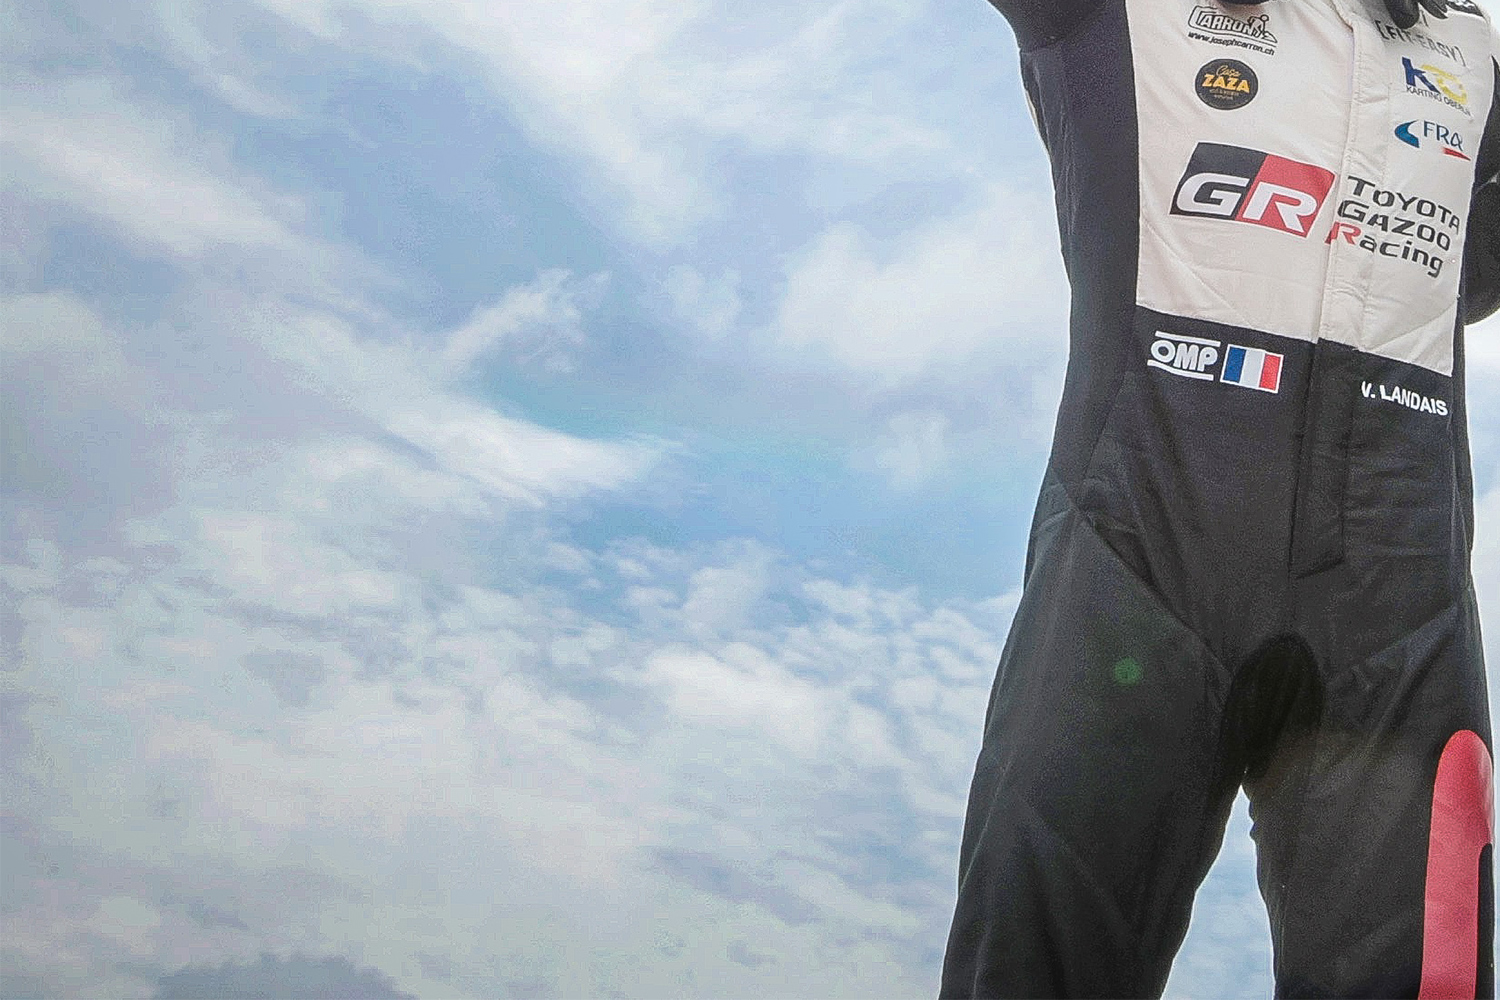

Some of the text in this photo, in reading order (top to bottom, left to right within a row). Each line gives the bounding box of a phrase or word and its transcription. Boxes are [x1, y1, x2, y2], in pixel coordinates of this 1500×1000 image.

[1202, 73, 1250, 94] ZAZA
[1176, 172, 1316, 233] GR
[1337, 200, 1451, 251] GAZOO
[1347, 176, 1460, 234] TOYOTA
[1325, 221, 1444, 278] Racing
[1151, 339, 1218, 372] OMP
[1361, 381, 1449, 416] V. LANDAIS
